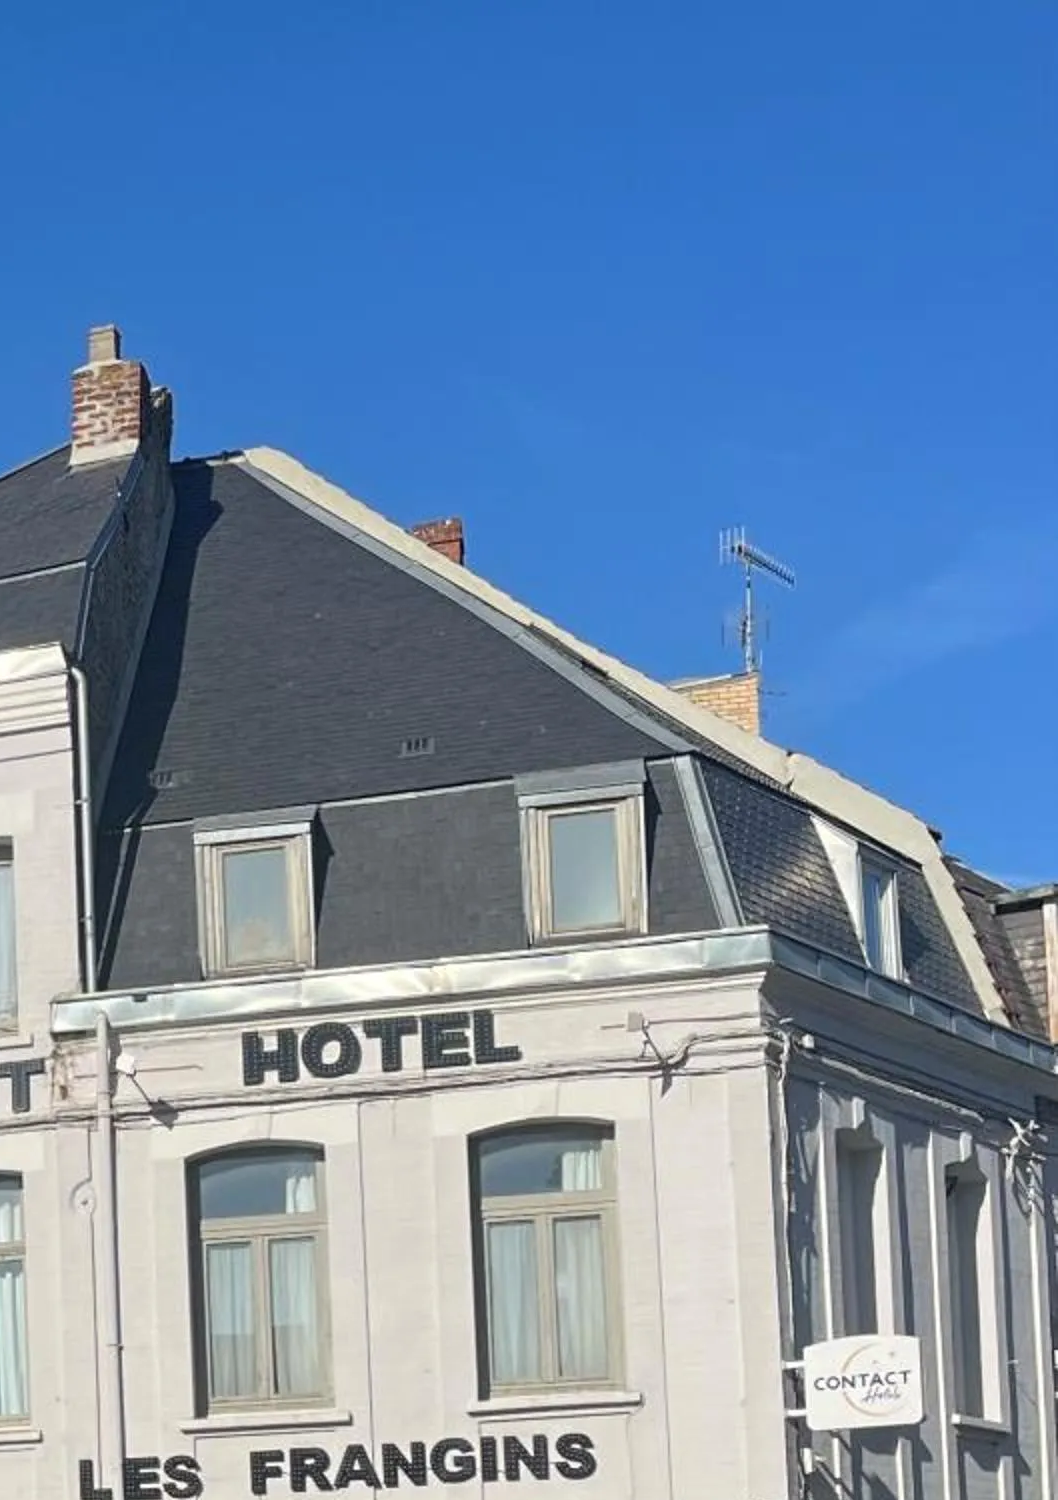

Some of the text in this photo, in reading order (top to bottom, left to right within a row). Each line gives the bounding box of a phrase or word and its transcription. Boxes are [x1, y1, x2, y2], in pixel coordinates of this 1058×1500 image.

[242, 1009, 522, 1086] HOTEL
[814, 1370, 910, 1391] CONTACT
[250, 1433, 597, 1495] FRANGINS
